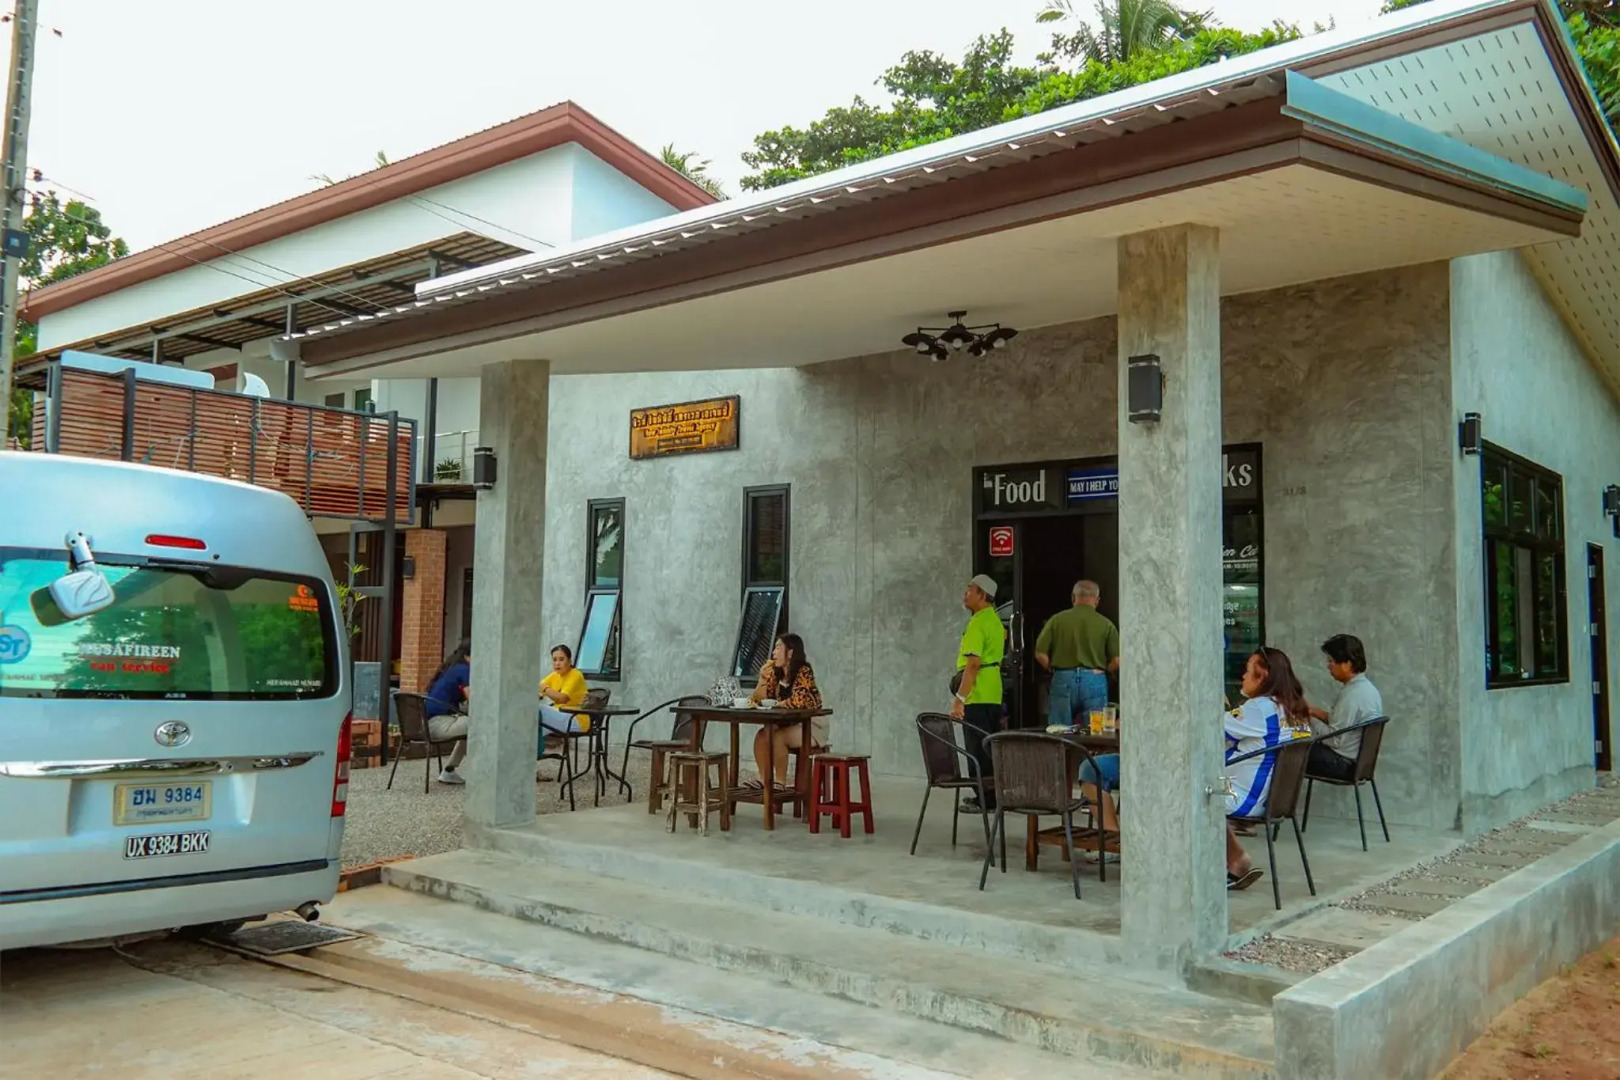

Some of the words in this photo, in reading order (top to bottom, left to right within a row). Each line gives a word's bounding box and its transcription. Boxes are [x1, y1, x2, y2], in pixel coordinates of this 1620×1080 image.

[994, 469, 1045, 505] Food
[1070, 482, 1085, 493] MAY
[1090, 480, 1107, 491] HELP
[122, 663, 169, 674] service
[165, 787, 202, 803] 9384
[127, 837, 146, 857] UX
[148, 835, 178, 856] 9384
[181, 832, 208, 853] BKK
